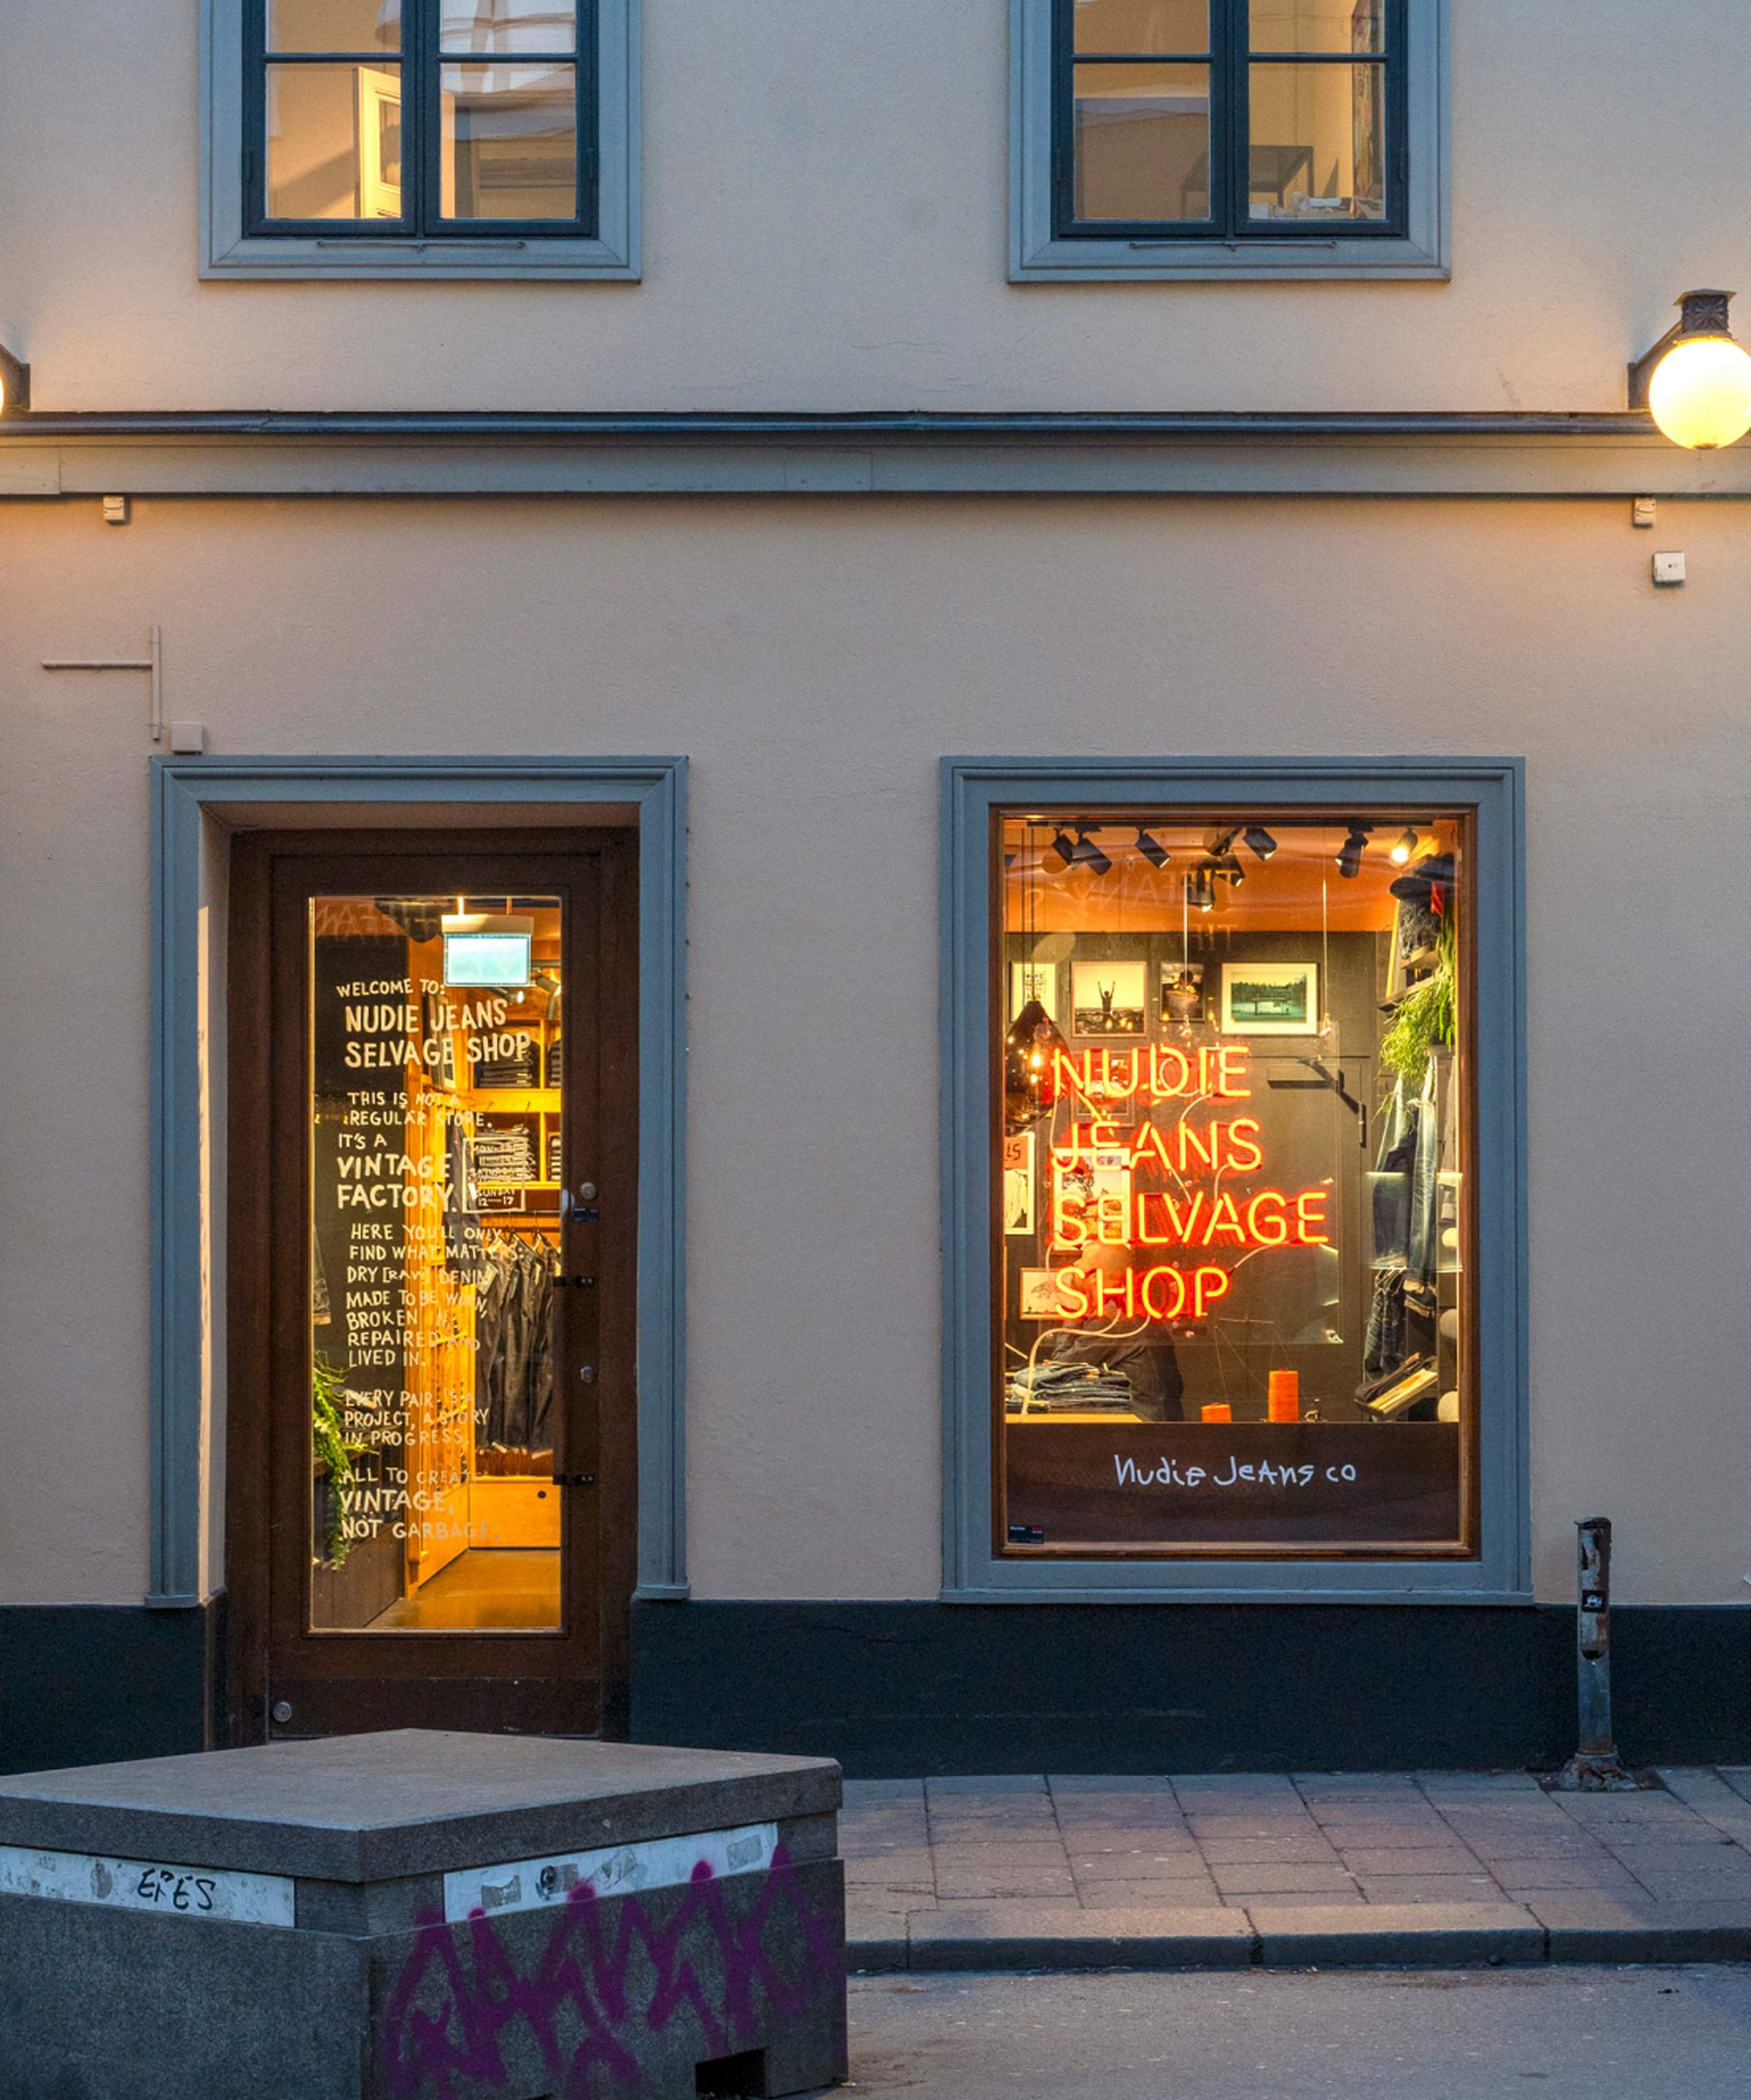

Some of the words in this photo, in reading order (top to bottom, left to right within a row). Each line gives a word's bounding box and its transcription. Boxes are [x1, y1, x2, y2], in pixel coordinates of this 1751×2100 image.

[336, 978, 414, 997] WELCOME
[420, 979, 445, 995] TO:
[345, 1004, 420, 1033] NUDIE
[430, 999, 508, 1031] JEANS
[344, 1039, 455, 1068] SELVAGE
[466, 1032, 531, 1063] SHOP
[1053, 1046, 1252, 1098] NUDIE
[347, 1091, 385, 1106] THIS
[393, 1092, 408, 1107] IS
[415, 1093, 444, 1107] NOT
[448, 1093, 461, 1107] A
[350, 1110, 426, 1126] REGULAR
[436, 1111, 492, 1128] STORE.
[339, 1133, 366, 1150] IT'S
[374, 1134, 387, 1147] A
[1051, 1119, 1262, 1172] JEANS
[336, 1153, 452, 1179] VINTAGE
[337, 1183, 457, 1212] FACTORY.
[1053, 1191, 1329, 1246] SELVAGE
[351, 1223, 393, 1240] HERE
[403, 1225, 455, 1240] YOU'LL
[463, 1226, 503, 1241] ONLY
[349, 1244, 387, 1260] FIND
[393, 1244, 441, 1260] WHAT
[446, 1243, 524, 1261] MATTERS:
[347, 1266, 378, 1284] DRY
[346, 1290, 390, 1309] MADE
[398, 1289, 415, 1306] TO
[419, 1291, 438, 1307] BE
[1055, 1266, 1229, 1319] SHOP
[347, 1309, 418, 1330] BROKEN
[347, 1330, 438, 1348] REPAIRED
[349, 1349, 396, 1367] LIVED
[403, 1352, 426, 1366] IN.
[345, 1389, 394, 1407] EVERY
[344, 1411, 416, 1430] PROJECT,
[423, 1412, 435, 1424] A
[439, 1408, 489, 1425] STORY
[345, 1432, 363, 1444] IN
[371, 1430, 470, 1446] PROGRESS.
[343, 1468, 379, 1484] ALL
[386, 1468, 409, 1484] TO
[339, 1488, 454, 1516] VINTAGE,
[341, 1516, 383, 1539] NOT
